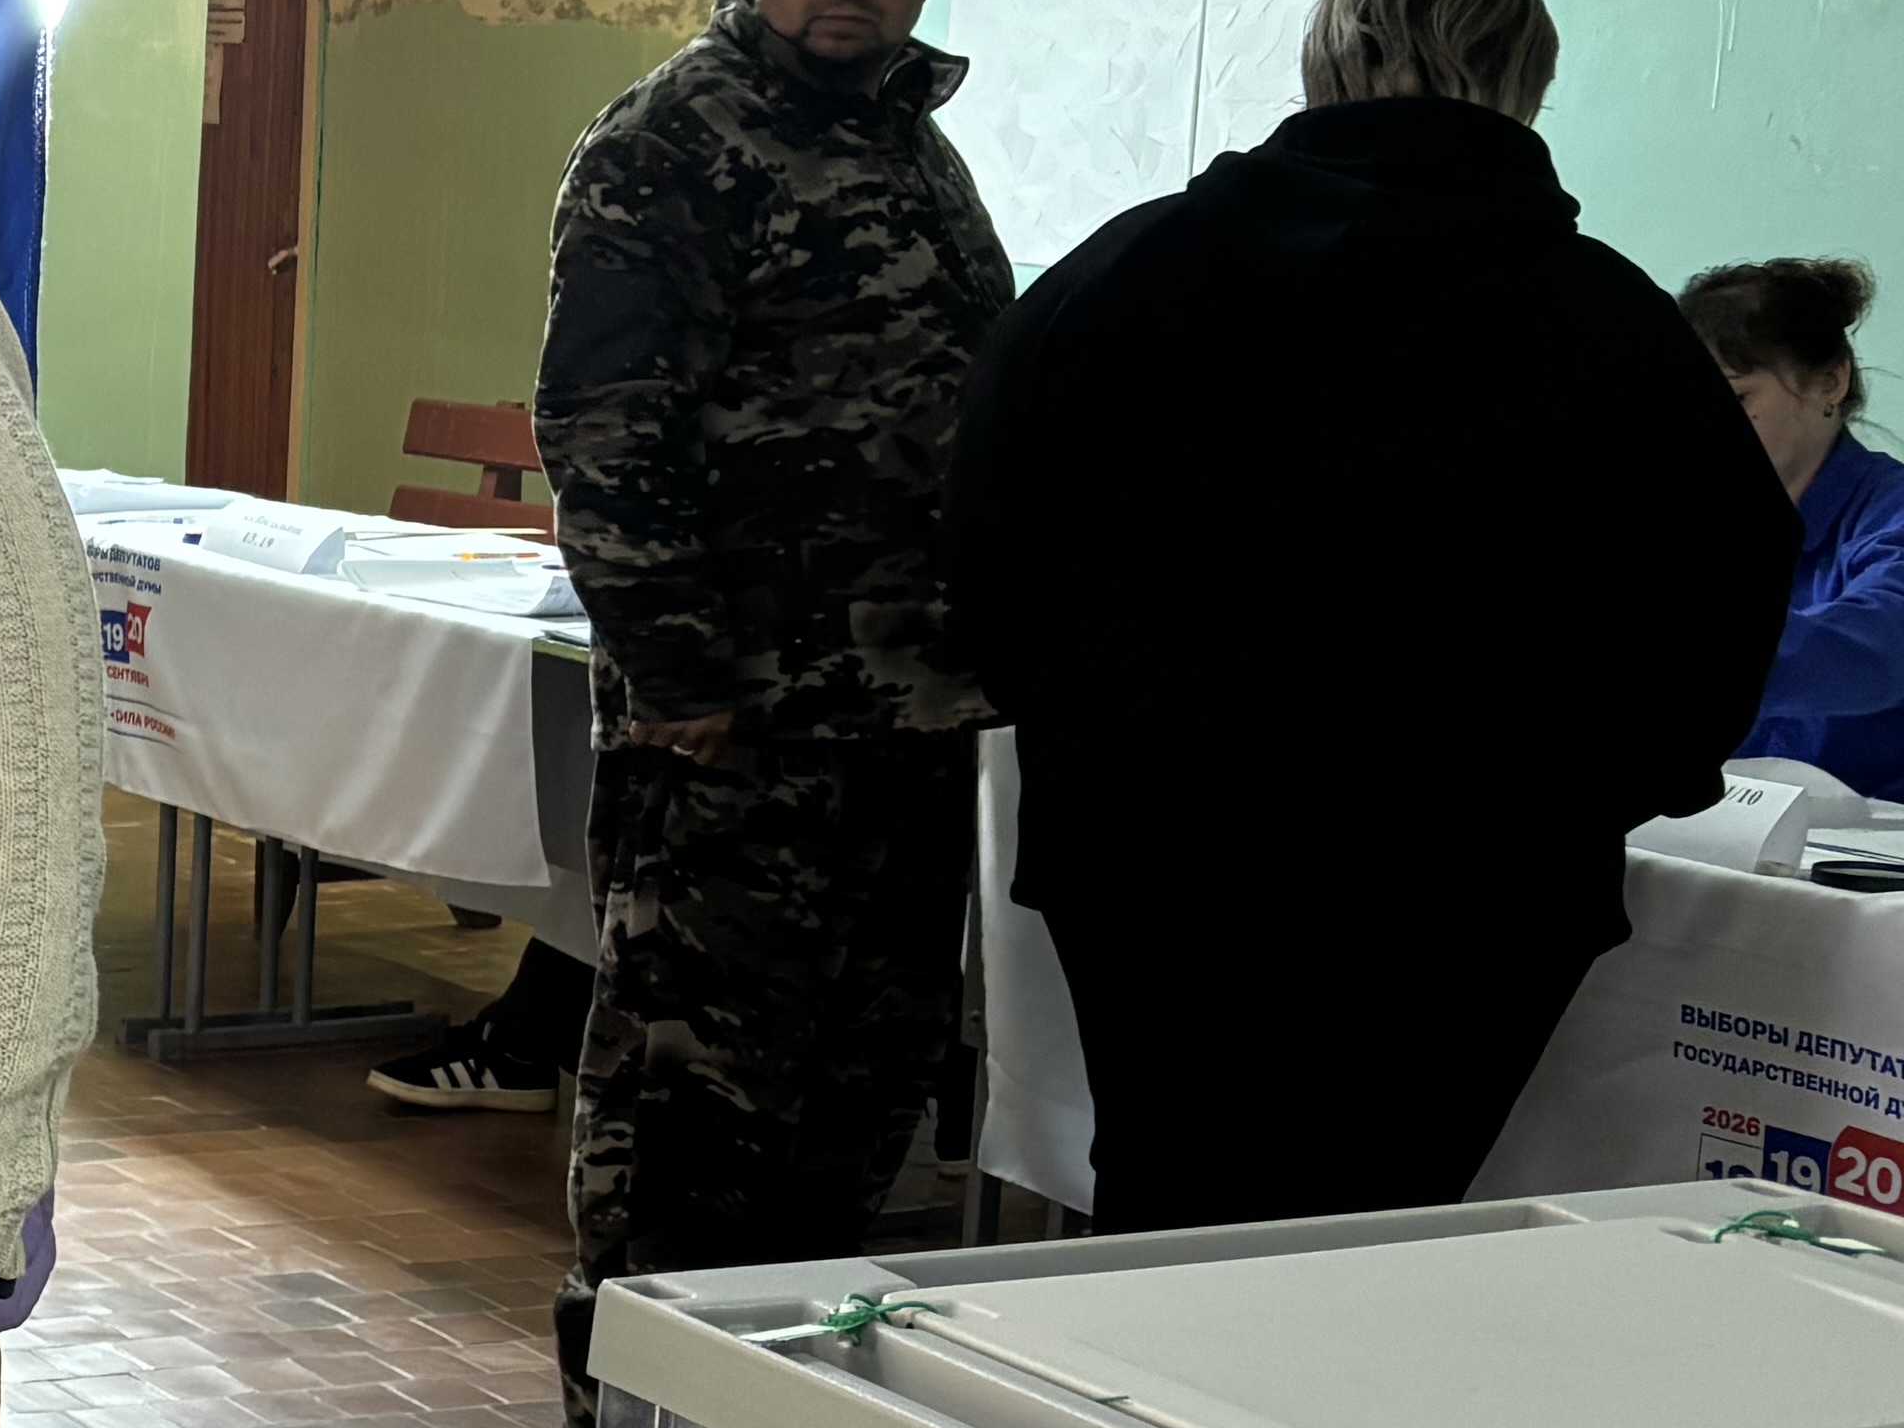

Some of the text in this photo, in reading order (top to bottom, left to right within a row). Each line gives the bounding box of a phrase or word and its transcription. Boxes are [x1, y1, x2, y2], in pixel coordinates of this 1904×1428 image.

[104, 614, 142, 651] 19 20
[1681, 1004, 1789, 1047] ВЫБОРЫ
[1673, 1041, 1879, 1107] ГОСУДАРСТВЕННОЙ
[1702, 1106, 1761, 1137] 2026
[1769, 1150, 1822, 1195] 19
[1834, 1147, 1902, 1204] 20
